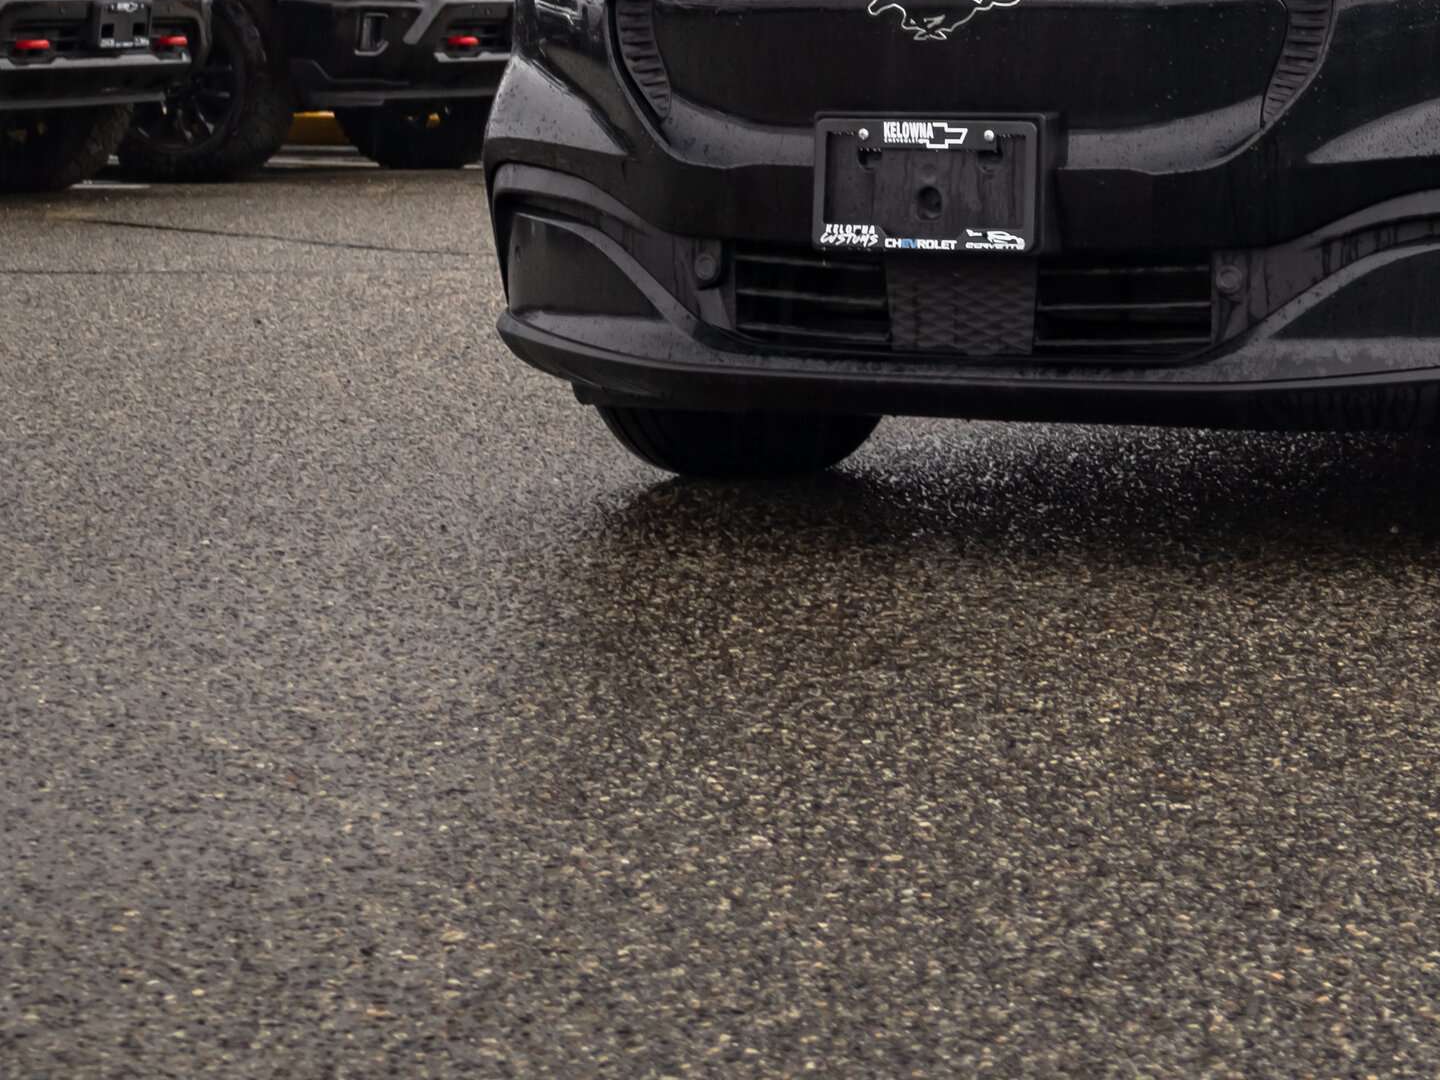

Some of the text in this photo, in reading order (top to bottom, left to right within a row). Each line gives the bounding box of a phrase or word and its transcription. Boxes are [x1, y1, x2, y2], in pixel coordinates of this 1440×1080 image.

[883, 121, 934, 139] KELOWNA
[820, 231, 879, 248] CUSTOMS
[884, 238, 958, 250] CHEVROLET
